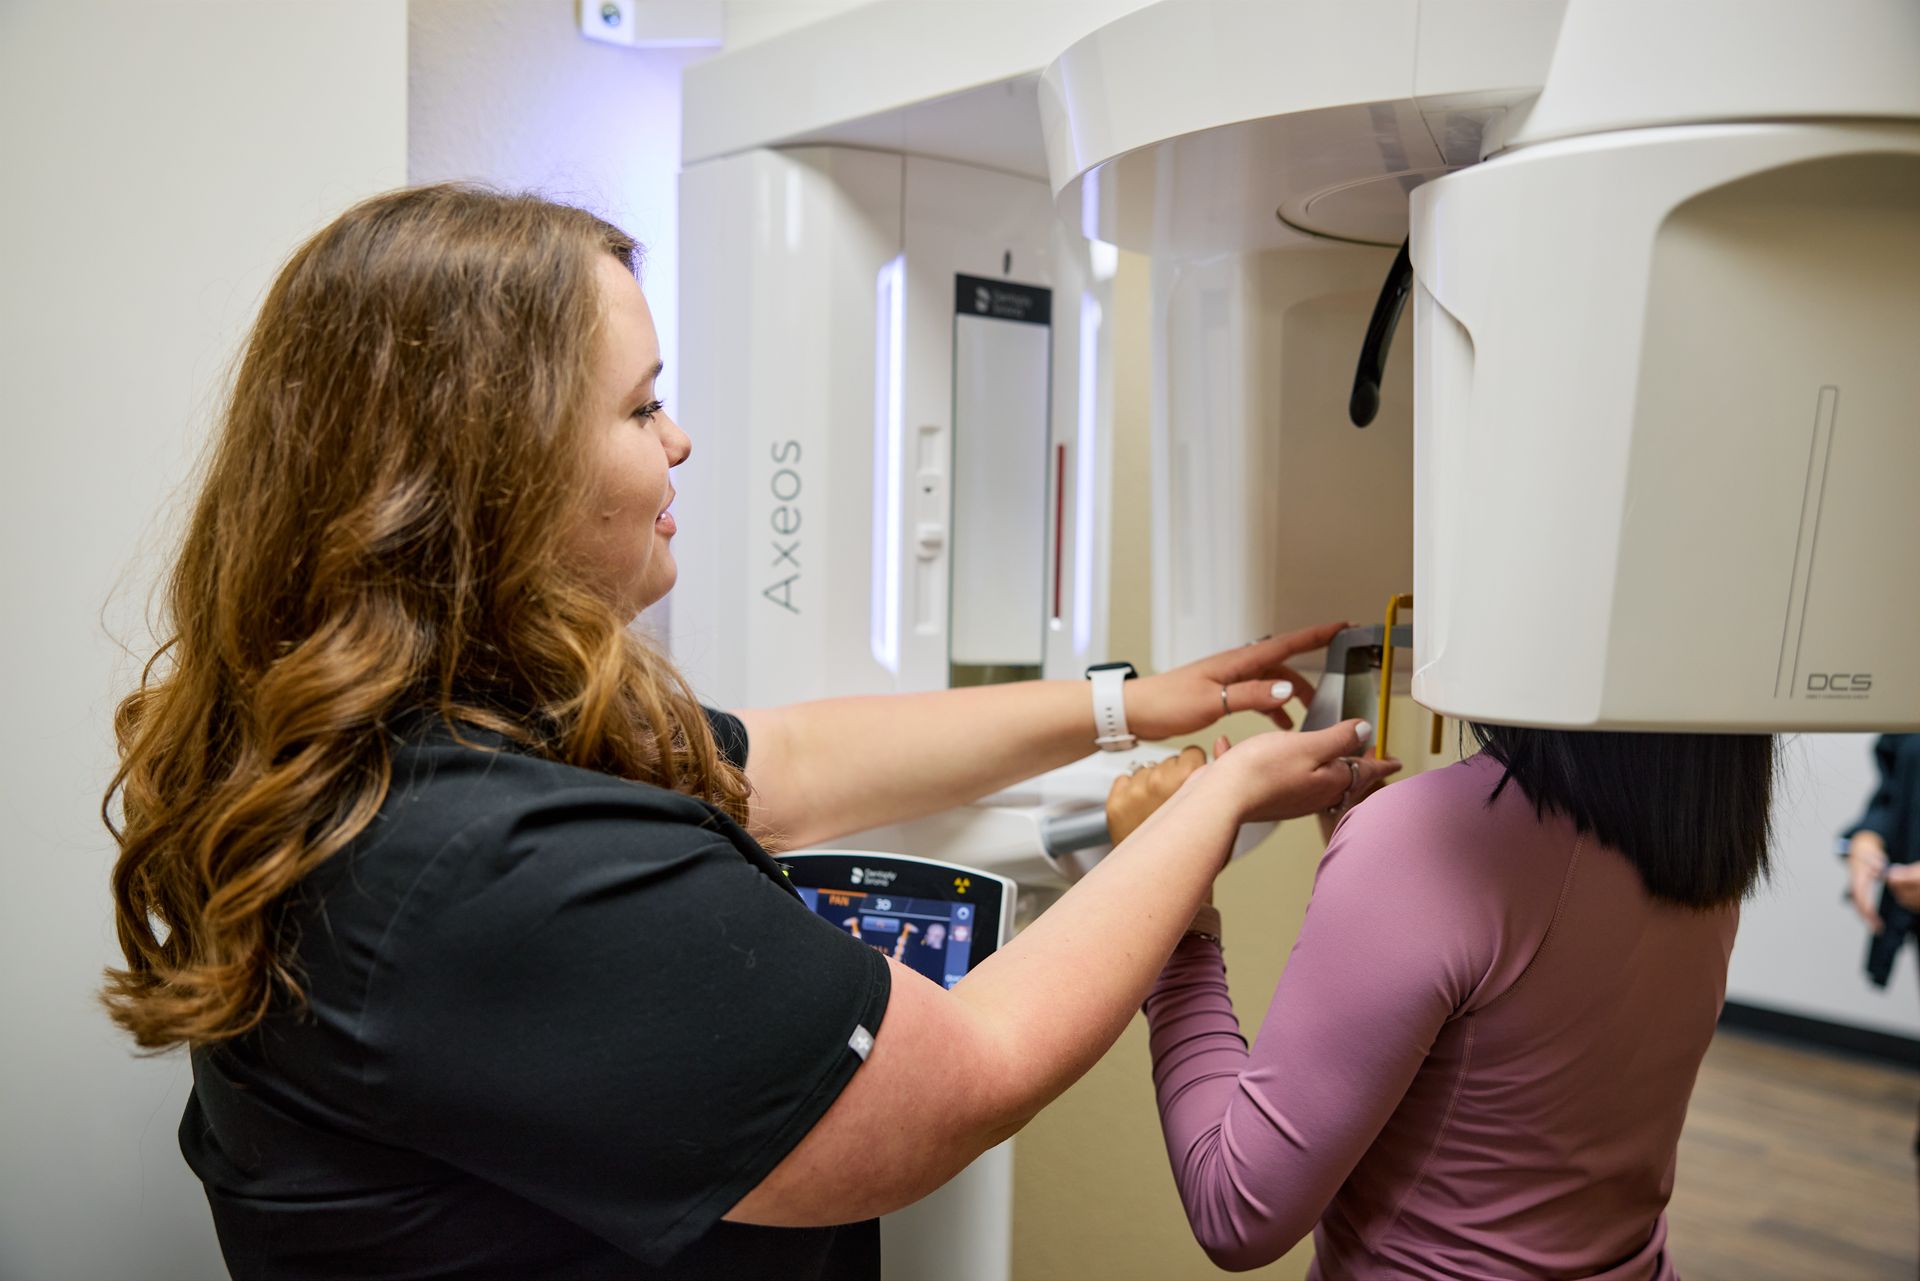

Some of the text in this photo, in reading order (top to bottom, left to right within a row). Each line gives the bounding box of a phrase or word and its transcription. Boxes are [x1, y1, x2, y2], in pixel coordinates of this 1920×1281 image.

[762, 440, 802, 614] Axeos
[1807, 673, 1872, 691] DCS
[829, 895, 849, 907] PAN
